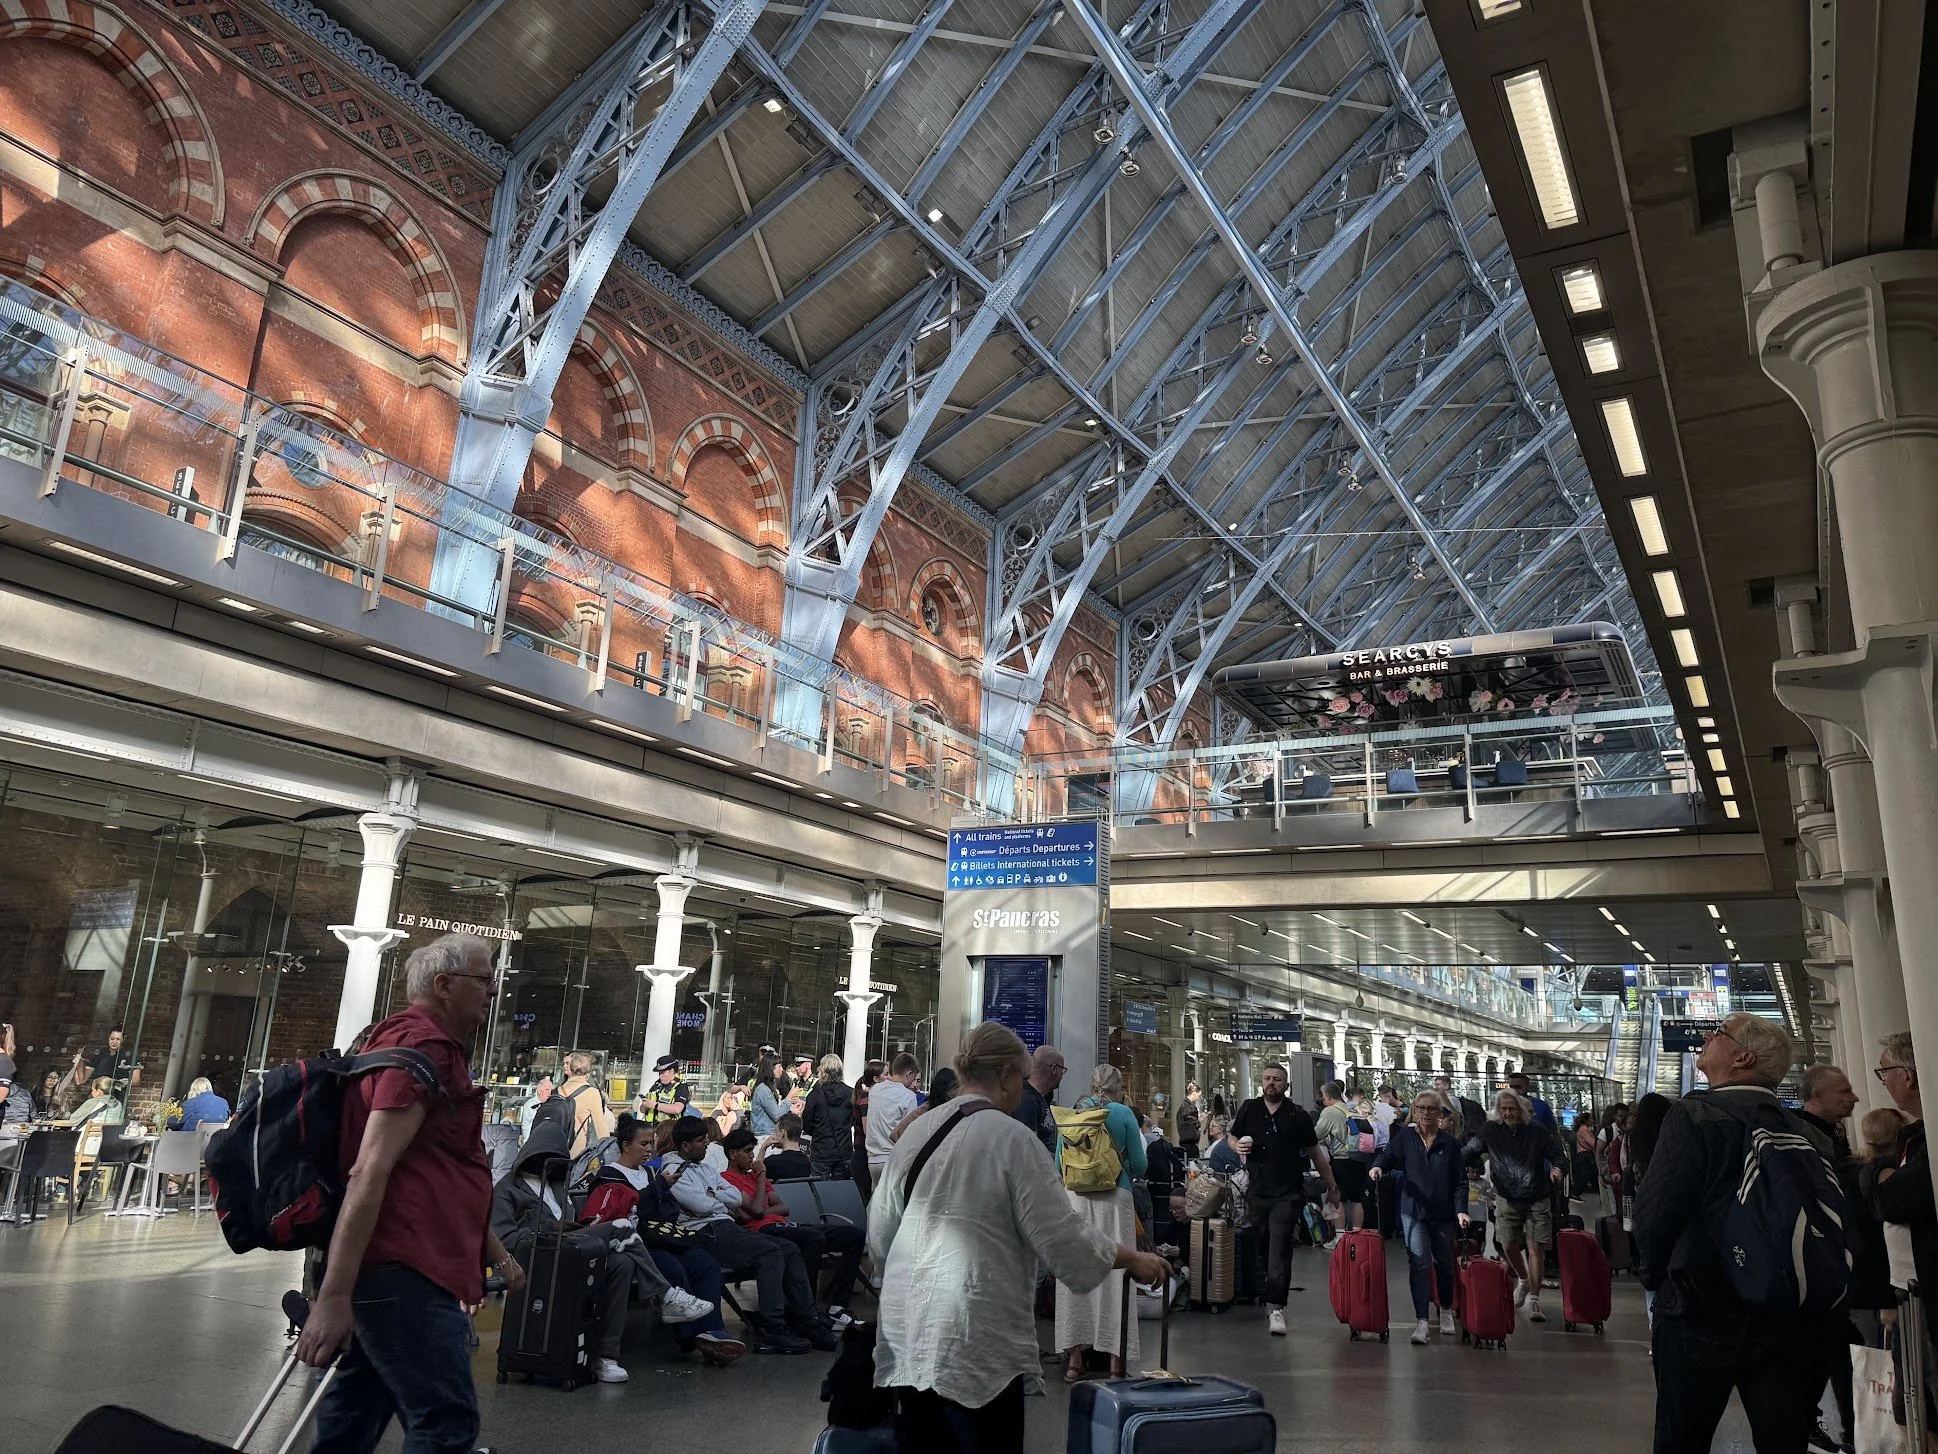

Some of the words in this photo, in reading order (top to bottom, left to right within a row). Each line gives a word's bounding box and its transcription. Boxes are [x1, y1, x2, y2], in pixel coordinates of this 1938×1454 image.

[1343, 642, 1451, 665] SEARCYS
[1350, 670, 1372, 680] BAR
[1374, 669, 1383, 677] &
[1386, 661, 1449, 676] BRASSERIE
[966, 833, 976, 841] All
[978, 832, 1002, 841] trains
[998, 845, 1031, 856] Départs
[1033, 844, 1080, 854] Departures
[969, 861, 996, 870] Billets
[997, 859, 1050, 869] International
[1051, 858, 1080, 867] tickets
[396, 913, 416, 926] LE
[418, 916, 450, 931] PAIN
[451, 921, 519, 941] QUOTIDIEN
[838, 976, 849, 985] LE
[1869, 1380, 1895, 1396] TRA
